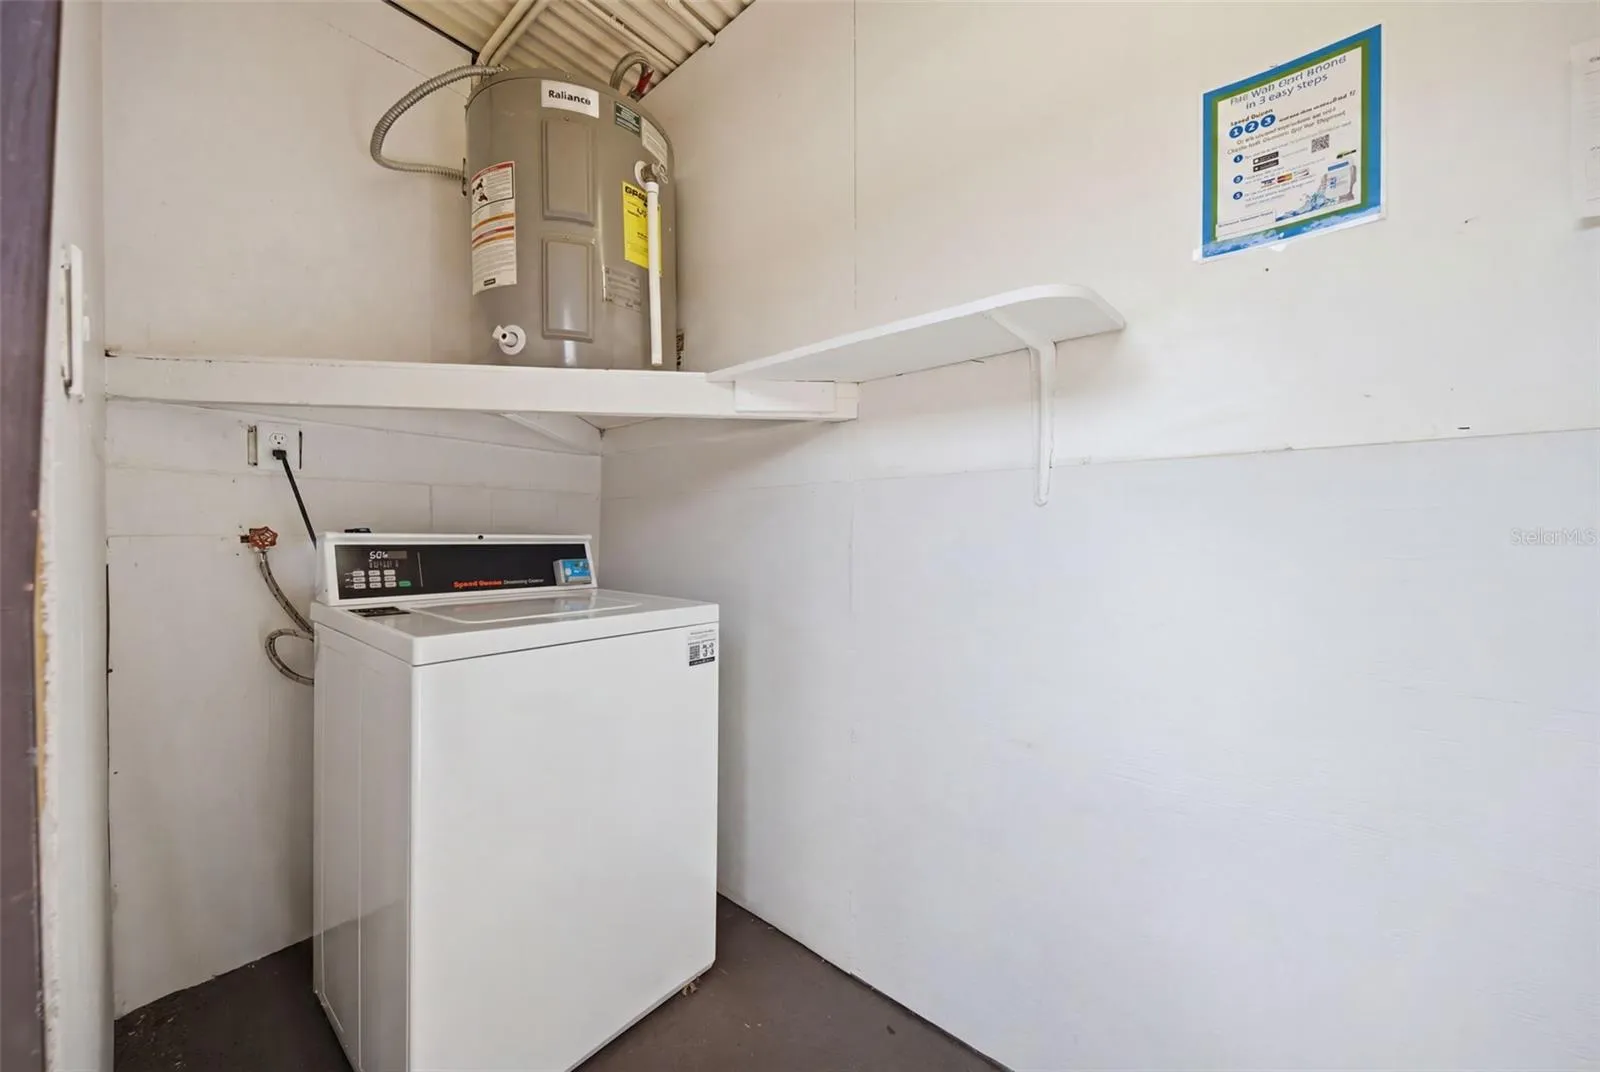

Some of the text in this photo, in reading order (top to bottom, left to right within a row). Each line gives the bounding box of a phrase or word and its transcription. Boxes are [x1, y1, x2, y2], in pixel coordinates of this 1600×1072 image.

[1245, 99, 1256, 110] in
[1259, 95, 1266, 105] 3
[1268, 86, 1294, 102] easy
[1296, 73, 1329, 91] steps
